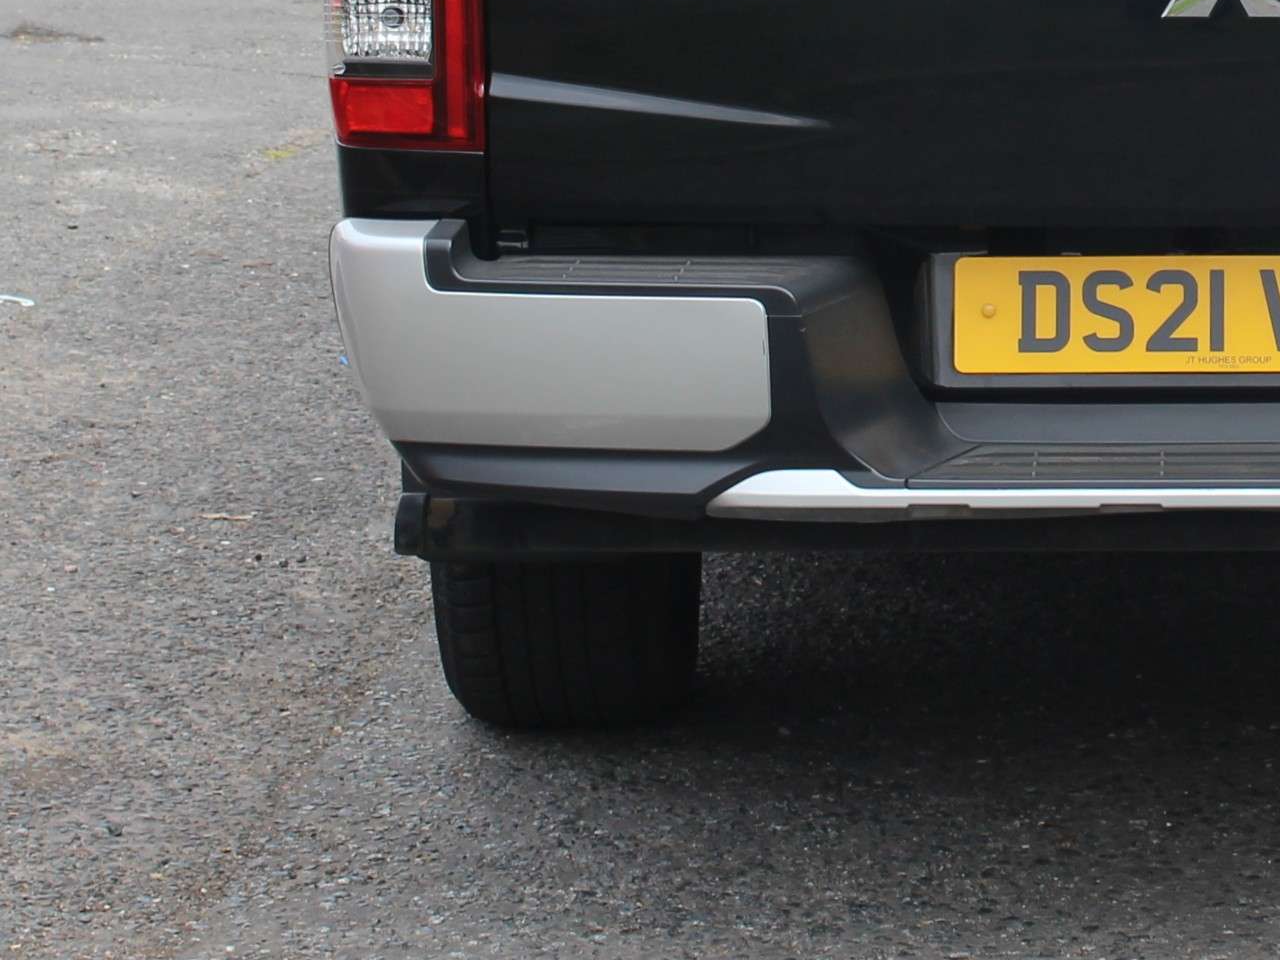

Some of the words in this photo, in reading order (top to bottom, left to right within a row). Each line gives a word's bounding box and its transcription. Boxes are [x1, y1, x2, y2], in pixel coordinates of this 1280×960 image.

[1017, 269, 1225, 353] DS21
[1198, 355, 1236, 364] HUGHES
[1239, 355, 1271, 364] GROUP
